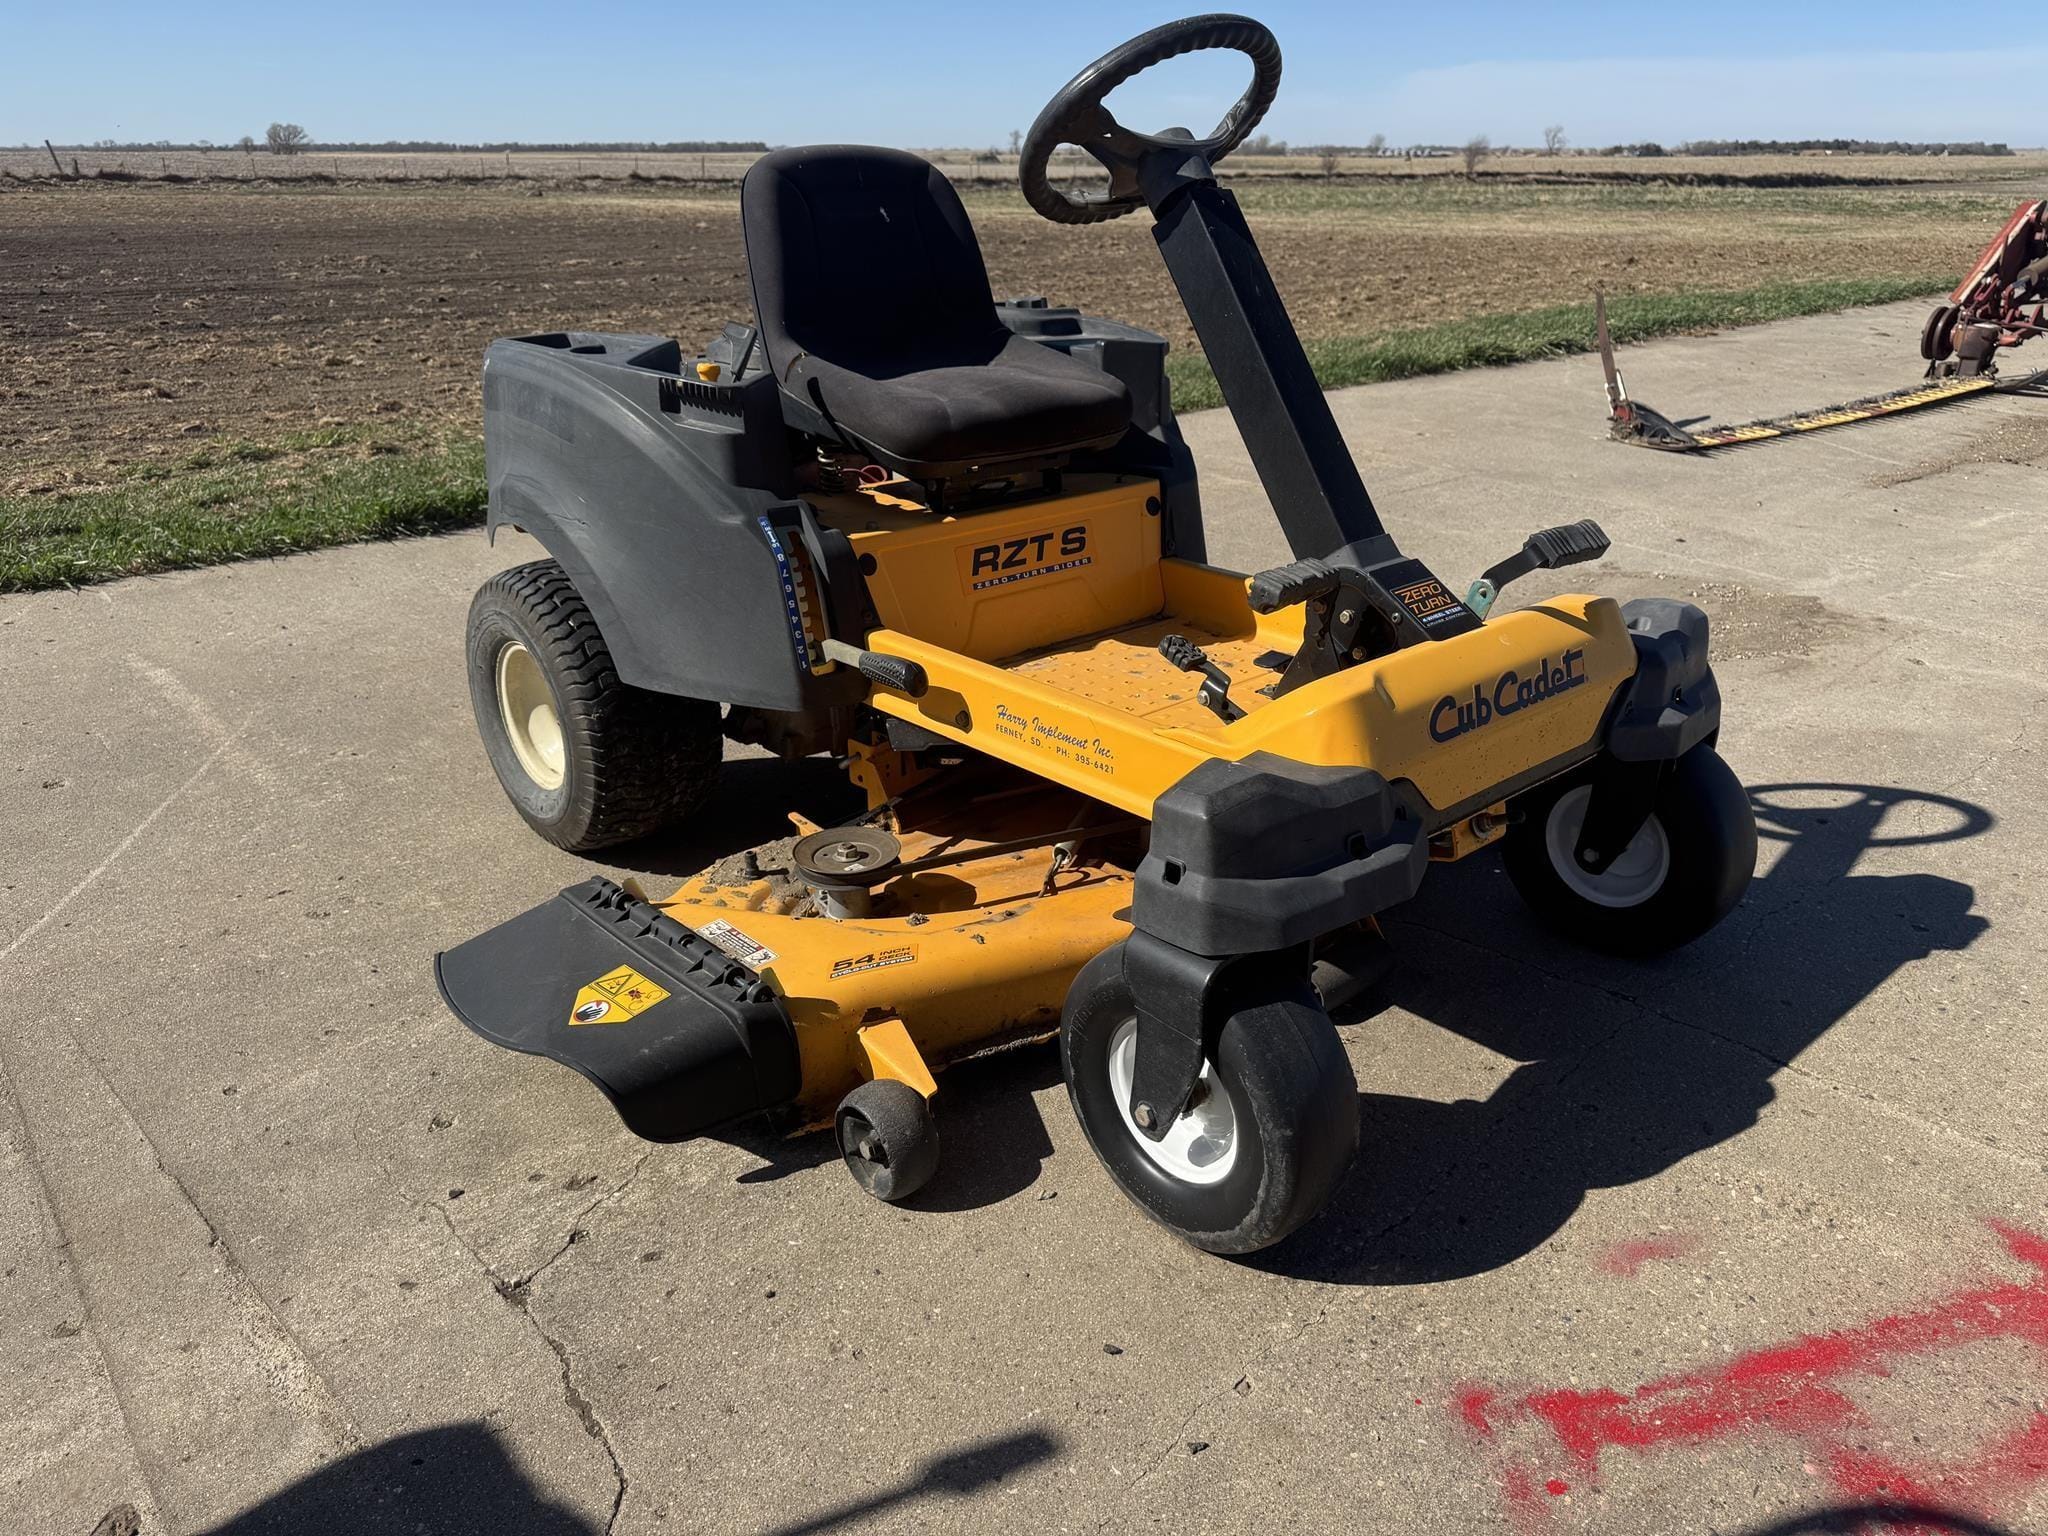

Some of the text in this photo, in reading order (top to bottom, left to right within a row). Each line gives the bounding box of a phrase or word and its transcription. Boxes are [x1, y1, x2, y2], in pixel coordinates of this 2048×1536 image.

[972, 526, 1087, 576] RZT S
[777, 553, 784, 561] 8
[1054, 558, 1089, 571] RIDER
[783, 568, 789, 577] 7
[785, 584, 792, 593] 6
[1401, 583, 1441, 604] ZERO
[788, 600, 795, 608] 5
[1409, 594, 1452, 614] TURN
[792, 615, 798, 624] 4
[795, 630, 801, 639] 3
[797, 645, 804, 654] 2
[801, 661, 807, 669] 1
[1430, 649, 1585, 743] Cub Cadet
[996, 704, 1114, 759] Harry Implement Inc.
[996, 724, 1027, 743] FERNEY,
[1056, 746, 1070, 759] PH:
[1075, 754, 1115, 774] 395-6421
[879, 951, 911, 961] DECK
[880, 946, 911, 956] INCH
[833, 954, 875, 971] 54
